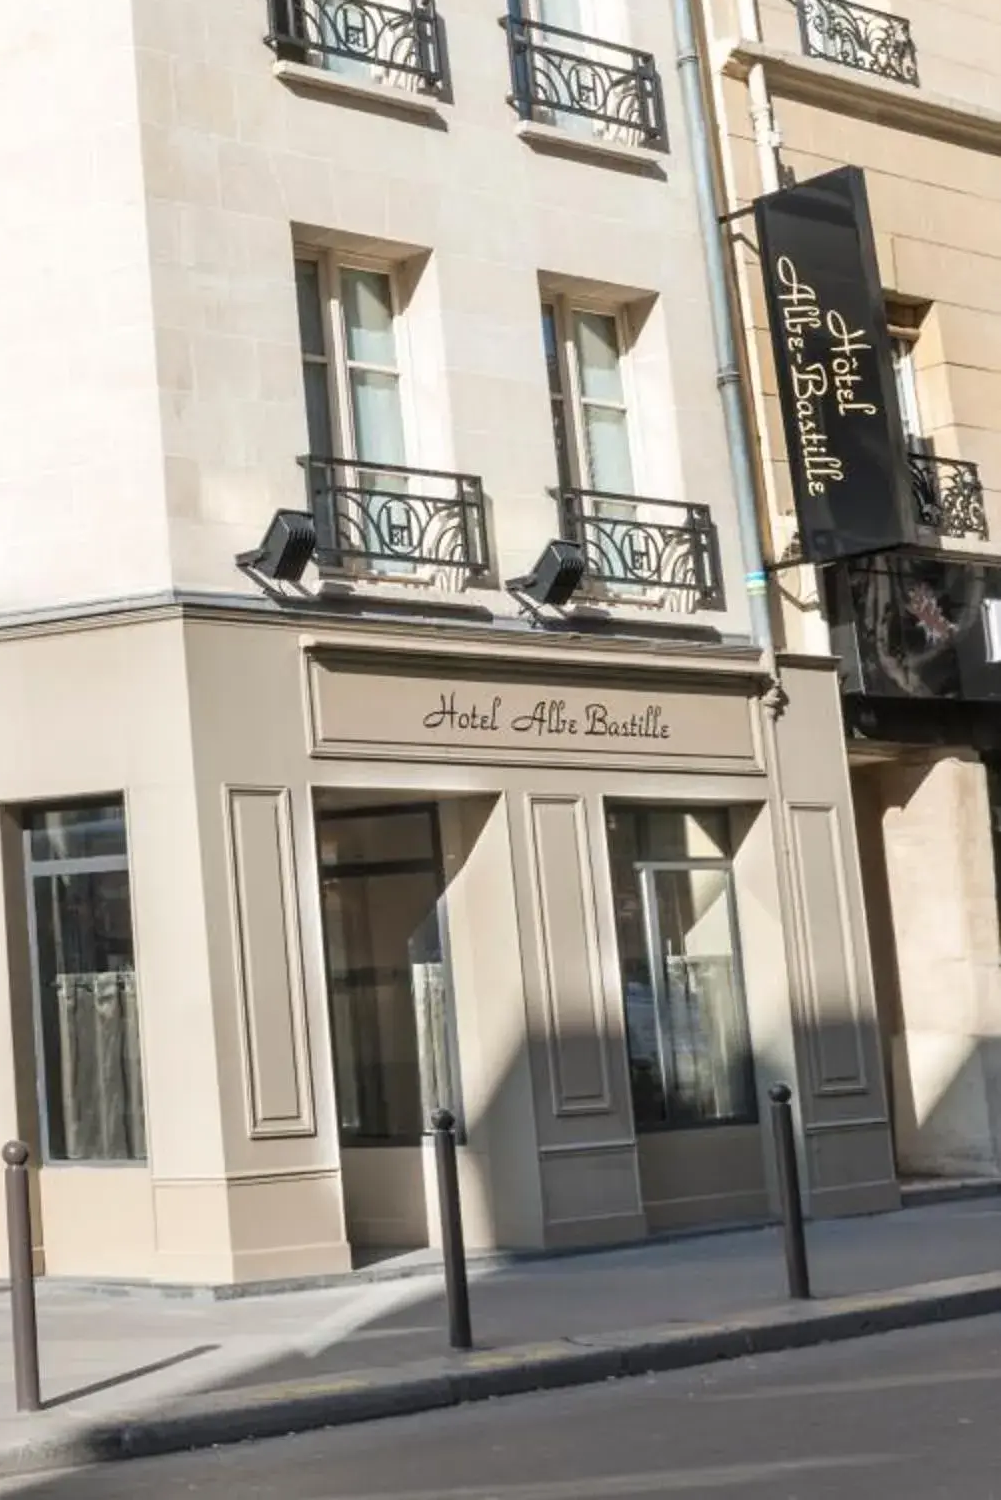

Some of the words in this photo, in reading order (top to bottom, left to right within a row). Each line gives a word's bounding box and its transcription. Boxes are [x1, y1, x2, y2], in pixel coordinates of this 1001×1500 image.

[826, 309, 877, 417] Hôtel
[422, 691, 502, 731] Hotel
[511, 700, 579, 737] Albe
[584, 703, 671, 739] Bastille
